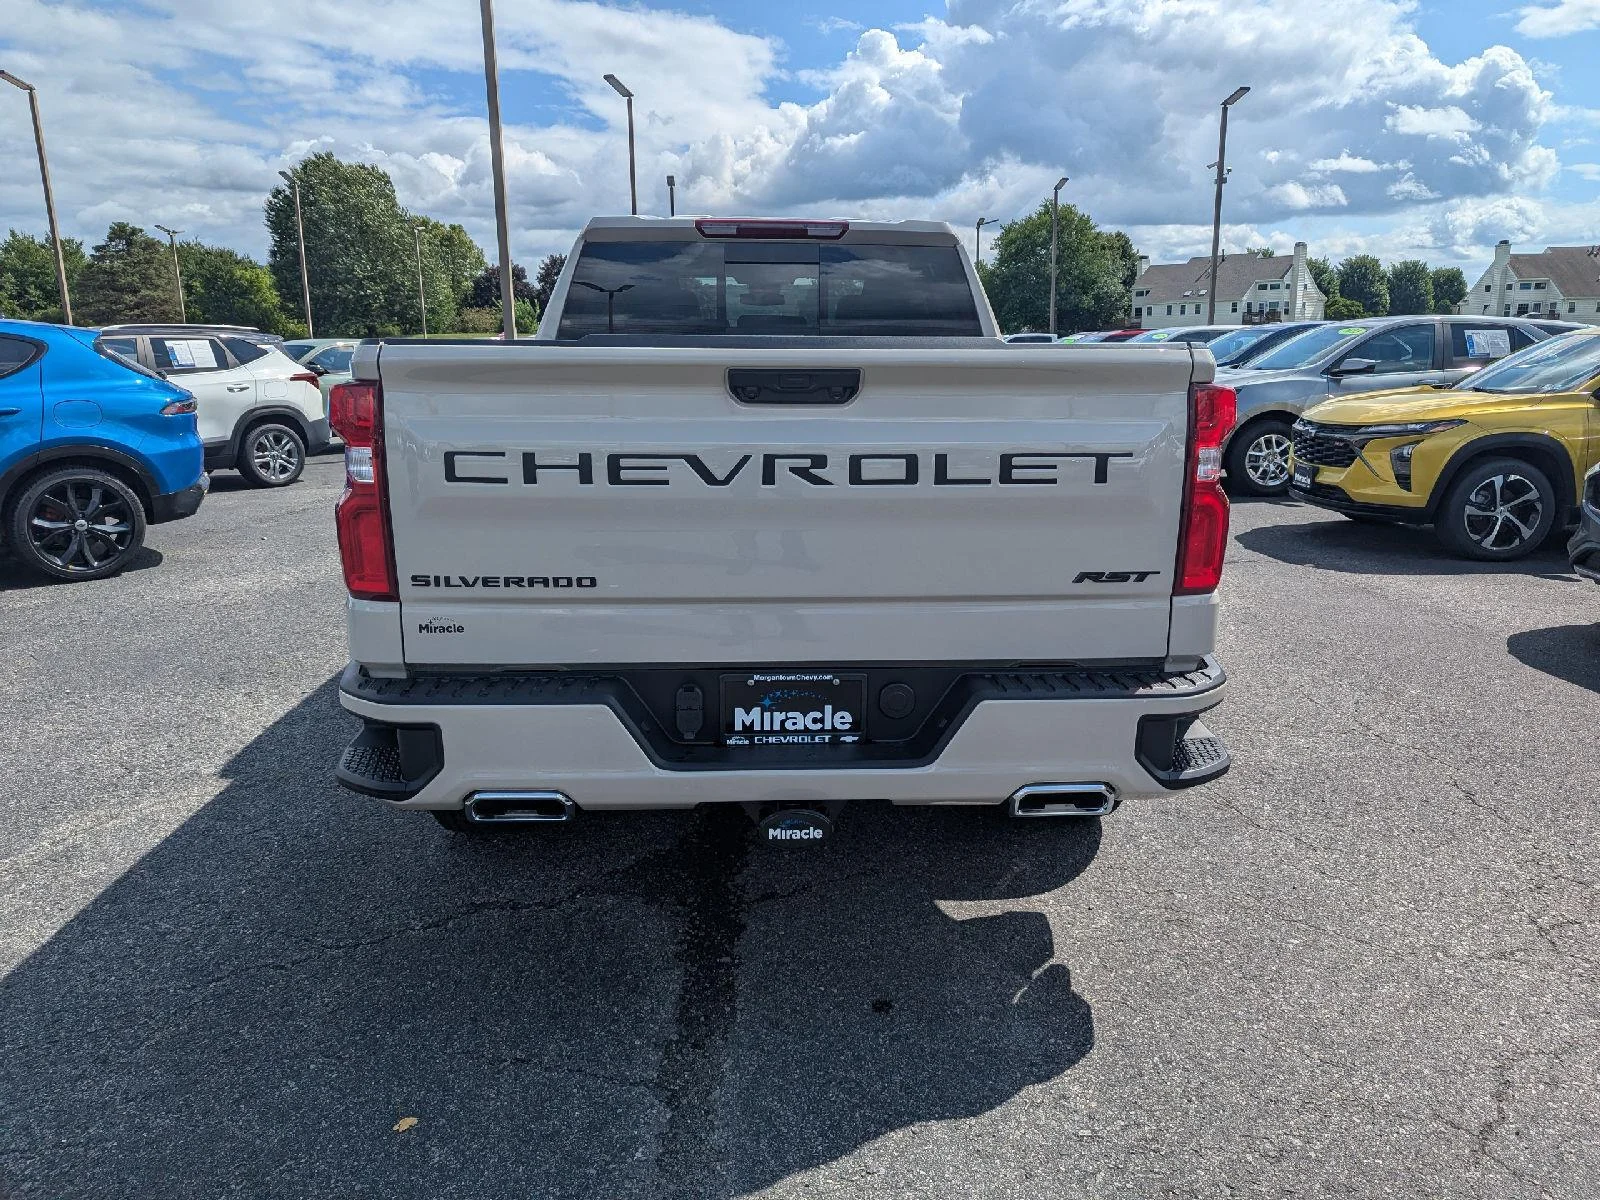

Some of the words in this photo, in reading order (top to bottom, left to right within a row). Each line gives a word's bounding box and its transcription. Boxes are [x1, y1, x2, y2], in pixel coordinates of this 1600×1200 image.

[443, 451, 1134, 486] CHEVROLET
[410, 574, 597, 588] SILVERADO
[1071, 571, 1161, 583] RST
[418, 623, 465, 634] Miracle
[753, 674, 833, 682] MorgantownChevy.com
[734, 704, 853, 731] Miracle
[754, 735, 832, 744] CHEVROLET
[768, 826, 823, 840] Miracle
